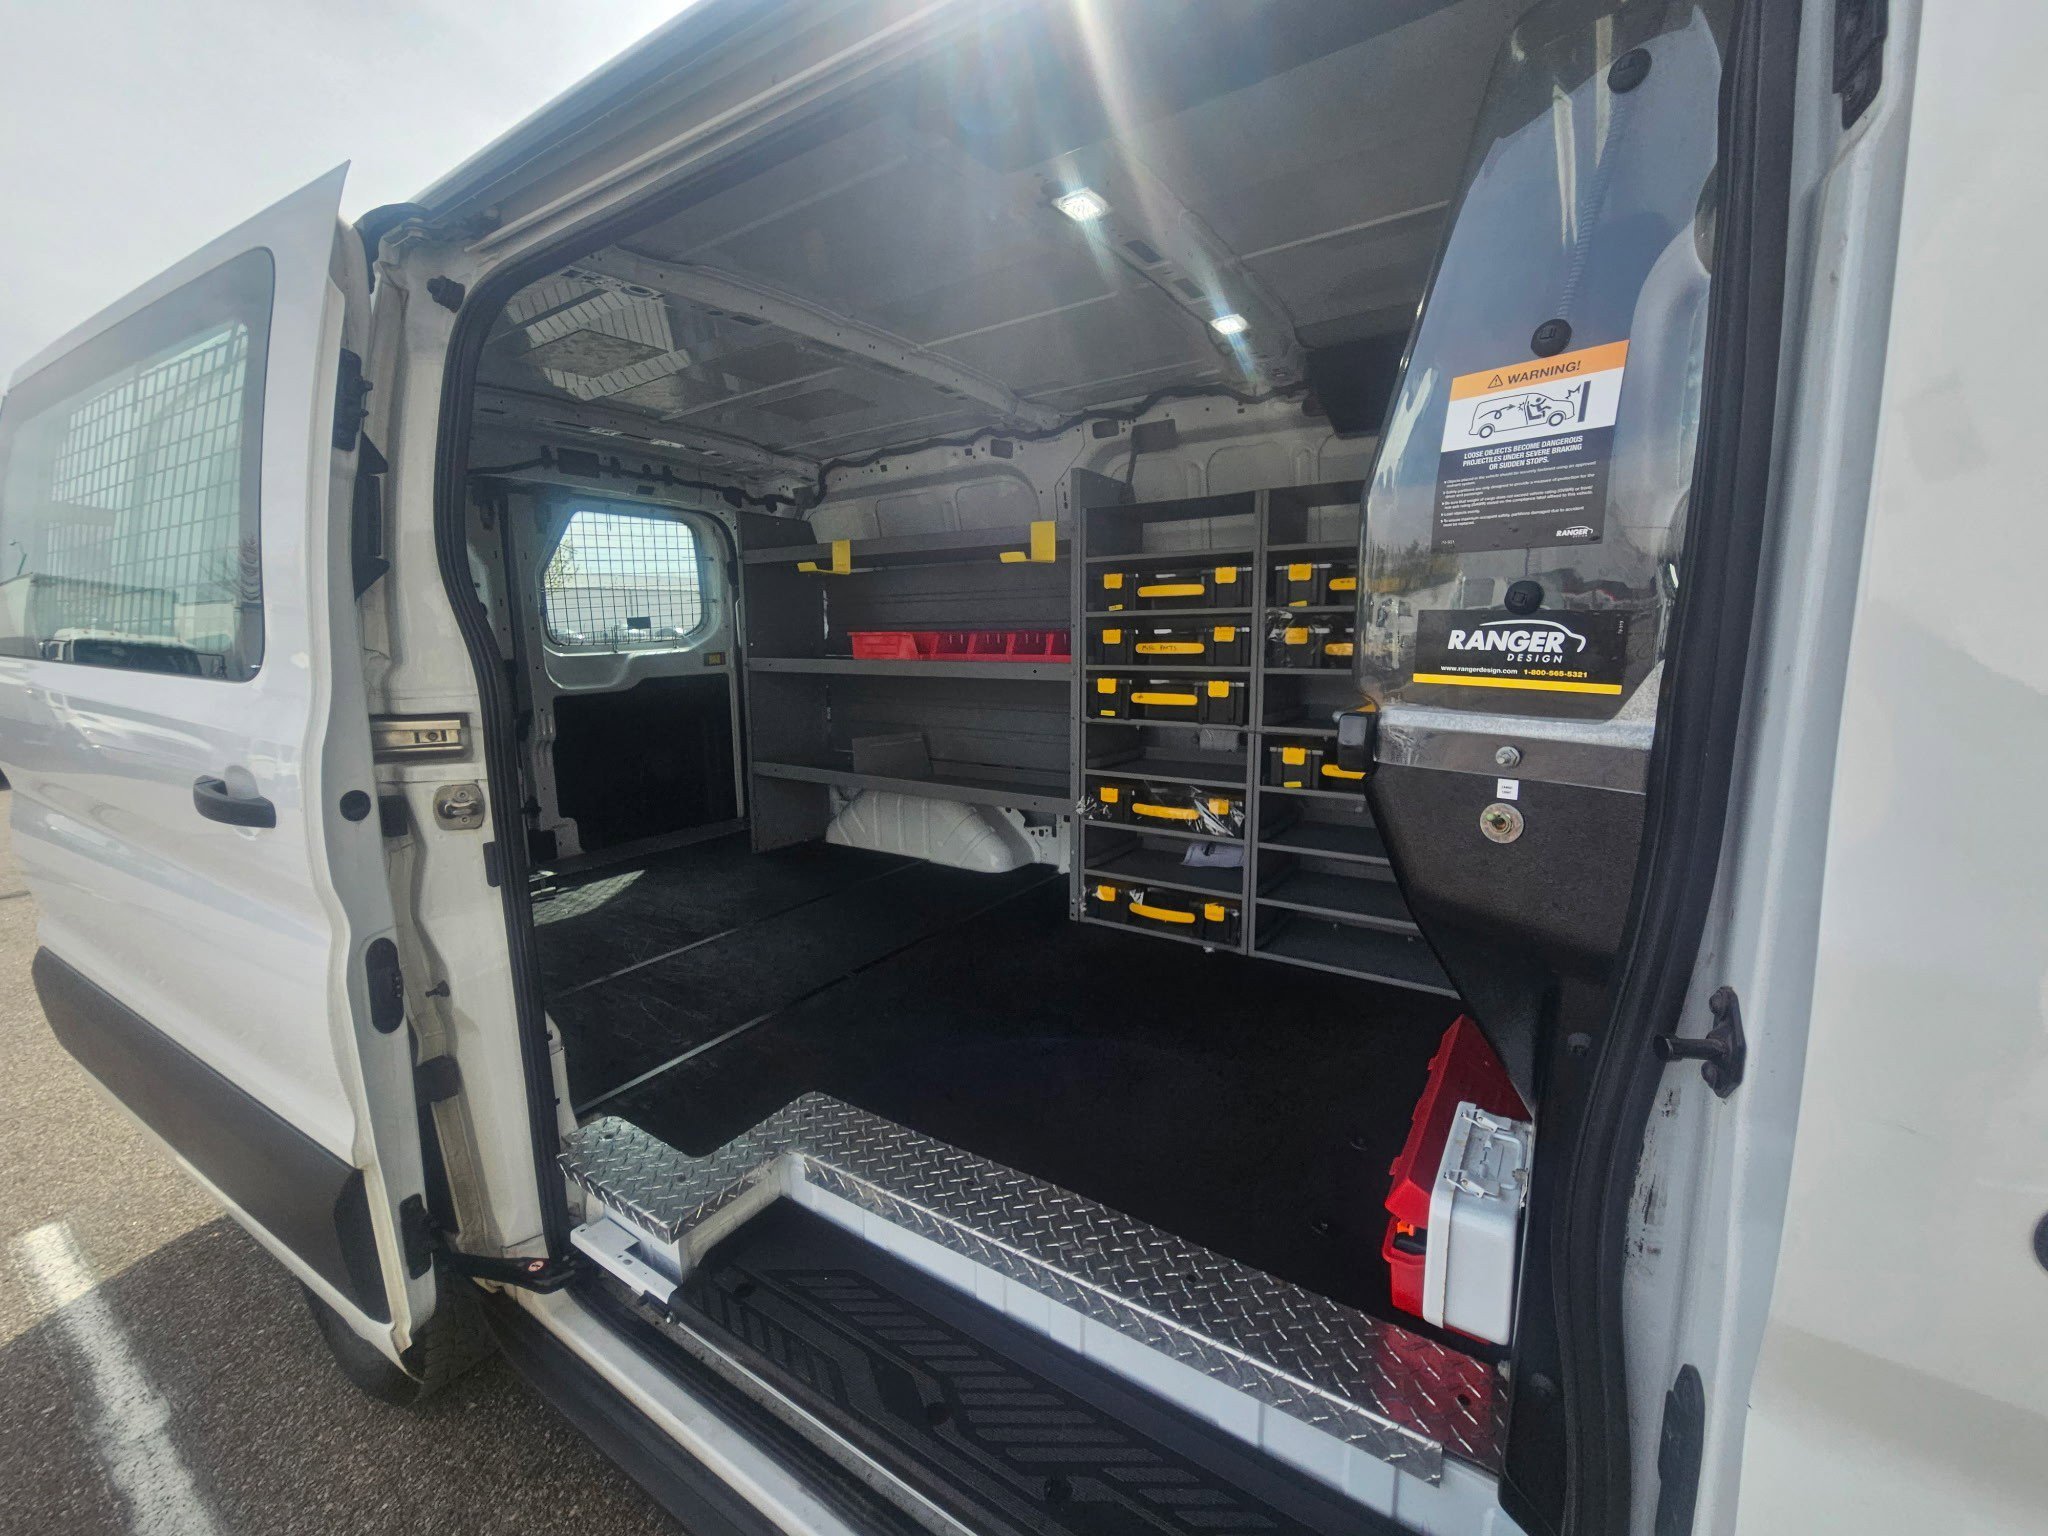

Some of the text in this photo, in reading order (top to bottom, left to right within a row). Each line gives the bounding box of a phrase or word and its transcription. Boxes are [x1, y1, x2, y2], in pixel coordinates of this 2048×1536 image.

[1508, 360, 1582, 384] WARNING!
[1484, 447, 1512, 457] OBJECTS
[1513, 442, 1540, 451] BECOME
[1541, 436, 1583, 448] DANGEROUS
[1462, 444, 1582, 467] PROJECTILES UNDER SEVERE BRAKING
[1499, 460, 1525, 469] SUDDEN
[1525, 456, 1549, 466] STOPS.
[1556, 528, 1588, 536] RANGER
[1448, 630, 1566, 653] RANGER
[1506, 653, 1563, 664] DESIGN
[1440, 665, 1588, 678] www.rangerdesign.com 1-800-565-5321
